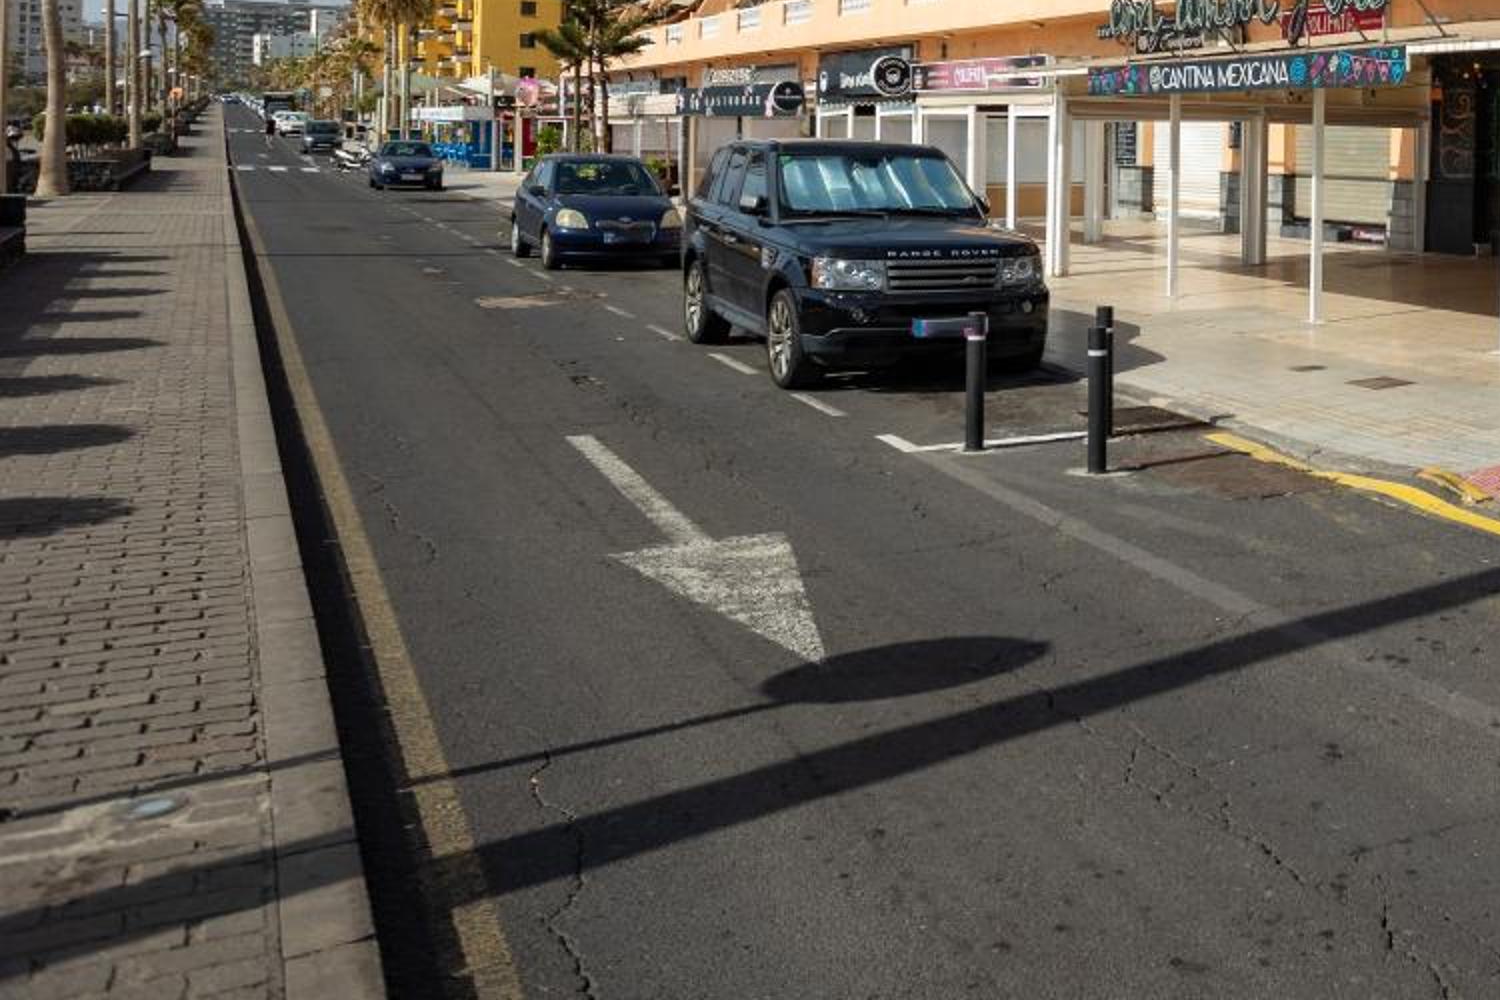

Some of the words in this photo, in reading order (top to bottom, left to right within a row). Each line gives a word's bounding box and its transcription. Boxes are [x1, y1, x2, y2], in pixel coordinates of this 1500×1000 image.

[1160, 64, 1215, 90] CANTINA
[1216, 60, 1290, 88] MEXICANA
[886, 249, 942, 258] RANGE
[950, 248, 1000, 257] ROVER
